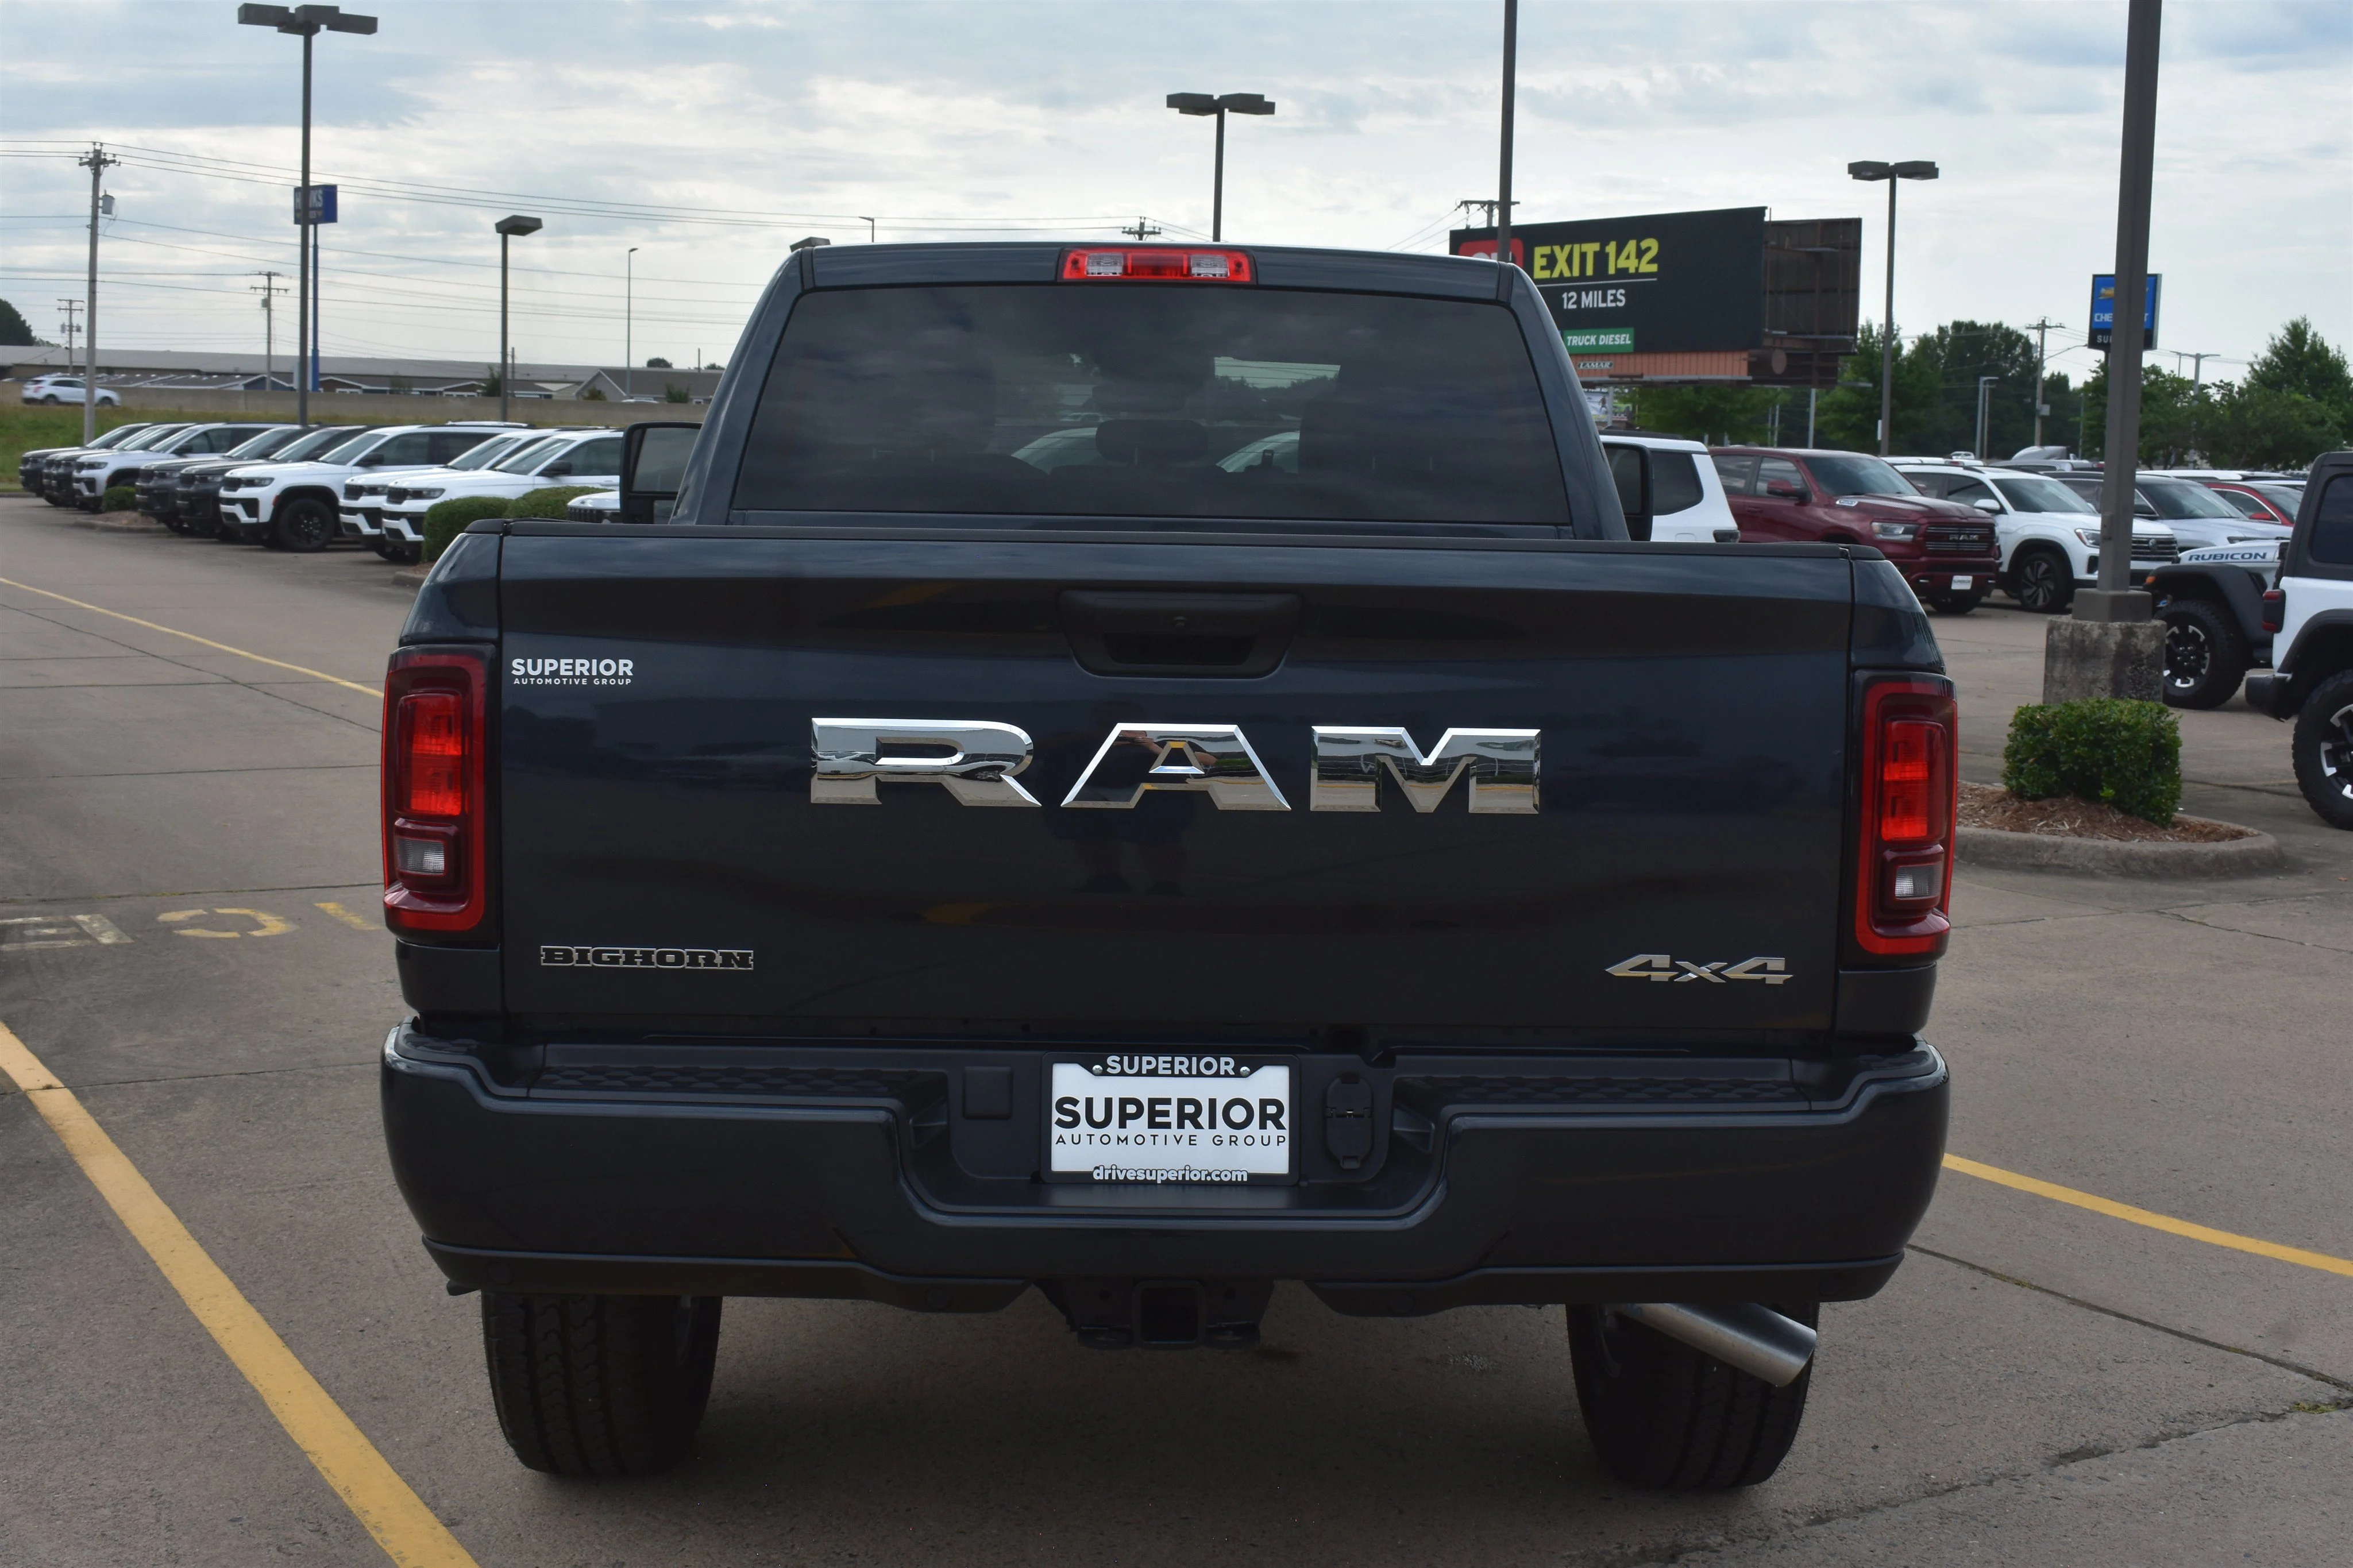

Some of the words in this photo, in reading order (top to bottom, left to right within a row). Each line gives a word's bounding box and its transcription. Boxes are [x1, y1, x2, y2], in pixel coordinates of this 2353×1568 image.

[1533, 242, 1600, 279] EXIT
[1606, 238, 1658, 275] 142
[1562, 292, 1577, 309] 12
[1581, 289, 1626, 308] MILES
[1567, 335, 1596, 346] TRUCK
[1599, 334, 1631, 345] DIESEL
[2188, 552, 2267, 561] RUBICON
[511, 658, 633, 676] SUPERIOR
[811, 717, 1541, 814] RAM
[540, 945, 754, 971] BIGHORN
[1106, 1055, 1235, 1076] SUPERIOR
[1054, 1096, 1287, 1130] SUPERIOR
[1055, 1134, 1198, 1146] AUTOMOTIVE
[1212, 1134, 1286, 1146] GROUP
[1093, 1164, 1248, 1184] drivesuperior.com
